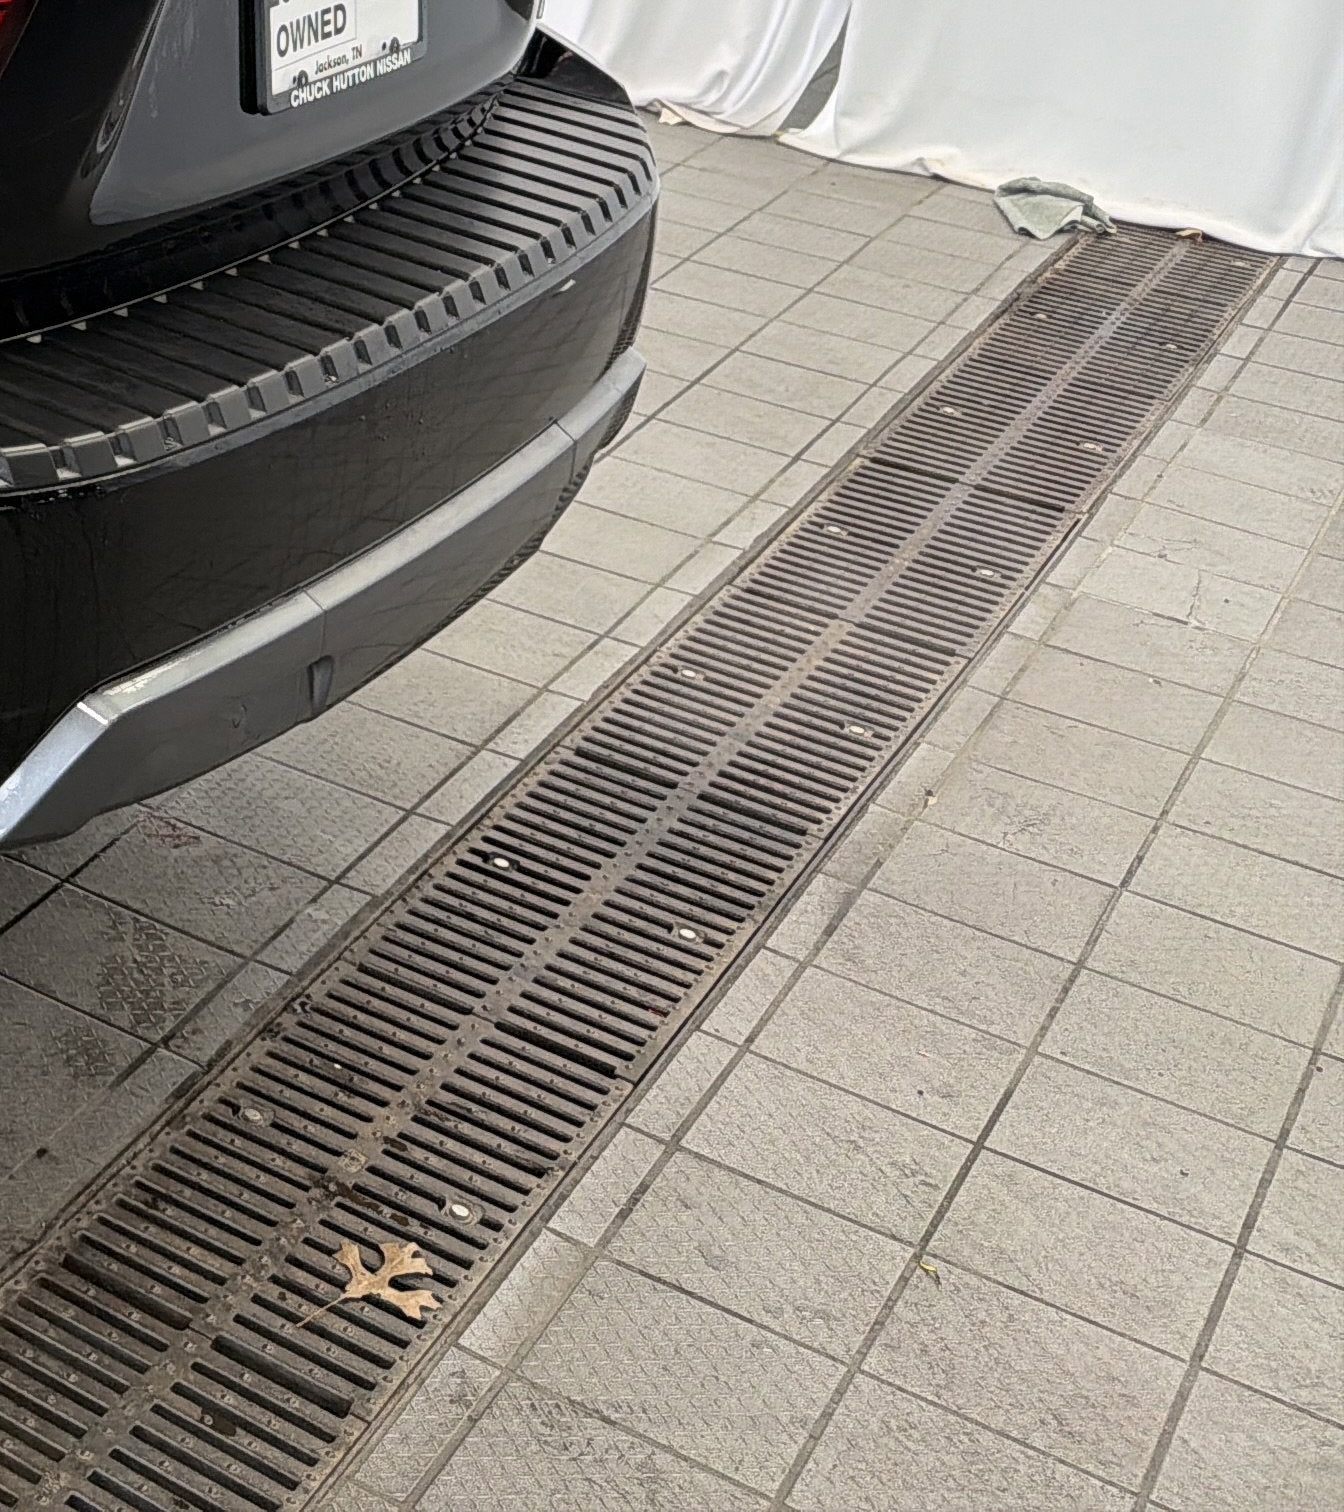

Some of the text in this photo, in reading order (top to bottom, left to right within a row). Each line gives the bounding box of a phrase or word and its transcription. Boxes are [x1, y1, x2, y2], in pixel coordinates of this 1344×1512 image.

[276, 3, 347, 57] OWNED
[290, 48, 412, 108] CHUCK HUTTON NISSAN
[315, 44, 363, 75] Jackson, TN
